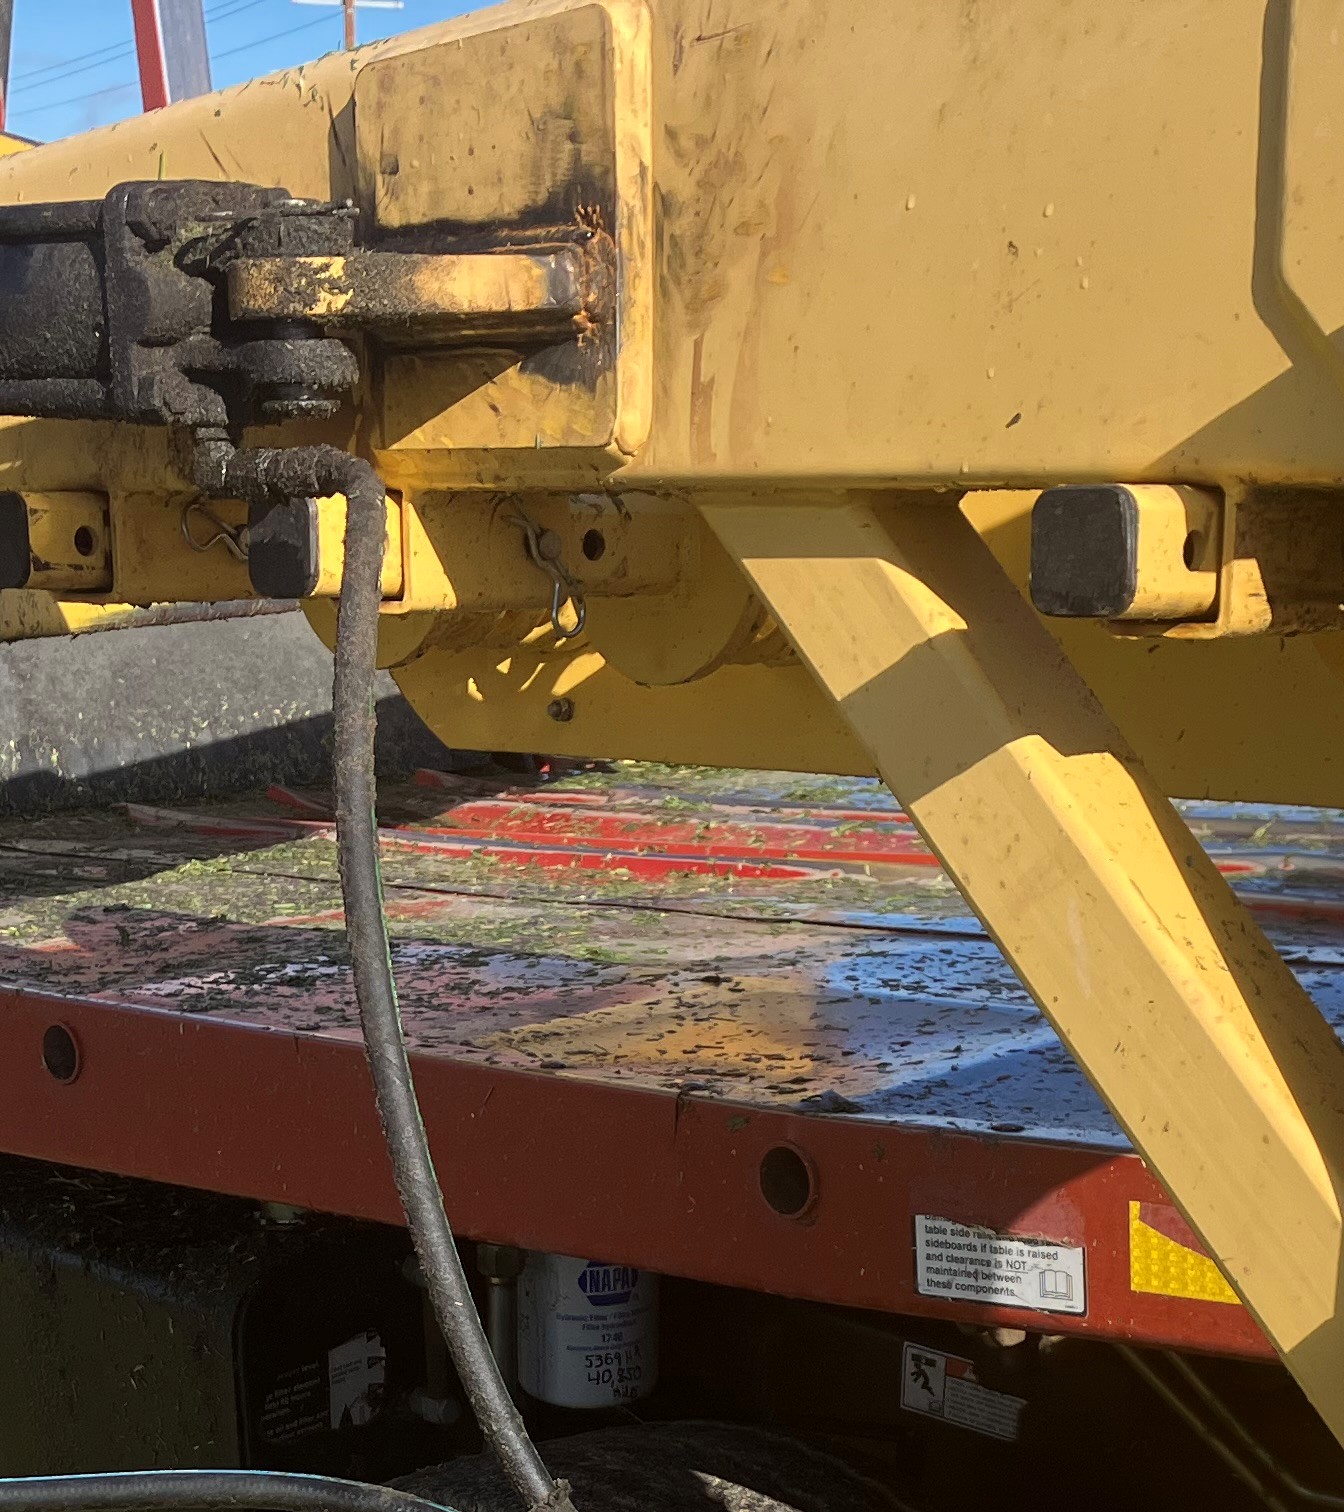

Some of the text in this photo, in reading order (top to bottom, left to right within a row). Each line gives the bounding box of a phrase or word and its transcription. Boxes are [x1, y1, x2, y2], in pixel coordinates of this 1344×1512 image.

[925, 1225, 948, 1236] table
[950, 1227, 970, 1238] side
[925, 1238, 1059, 1260] sideboards if table is raised
[925, 1251, 1027, 1271] and clearance is NOT
[588, 1267, 631, 1294] NAPA
[926, 1265, 1022, 1283] maintained between
[926, 1277, 952, 1289] these
[585, 1351, 621, 1369] 5369
